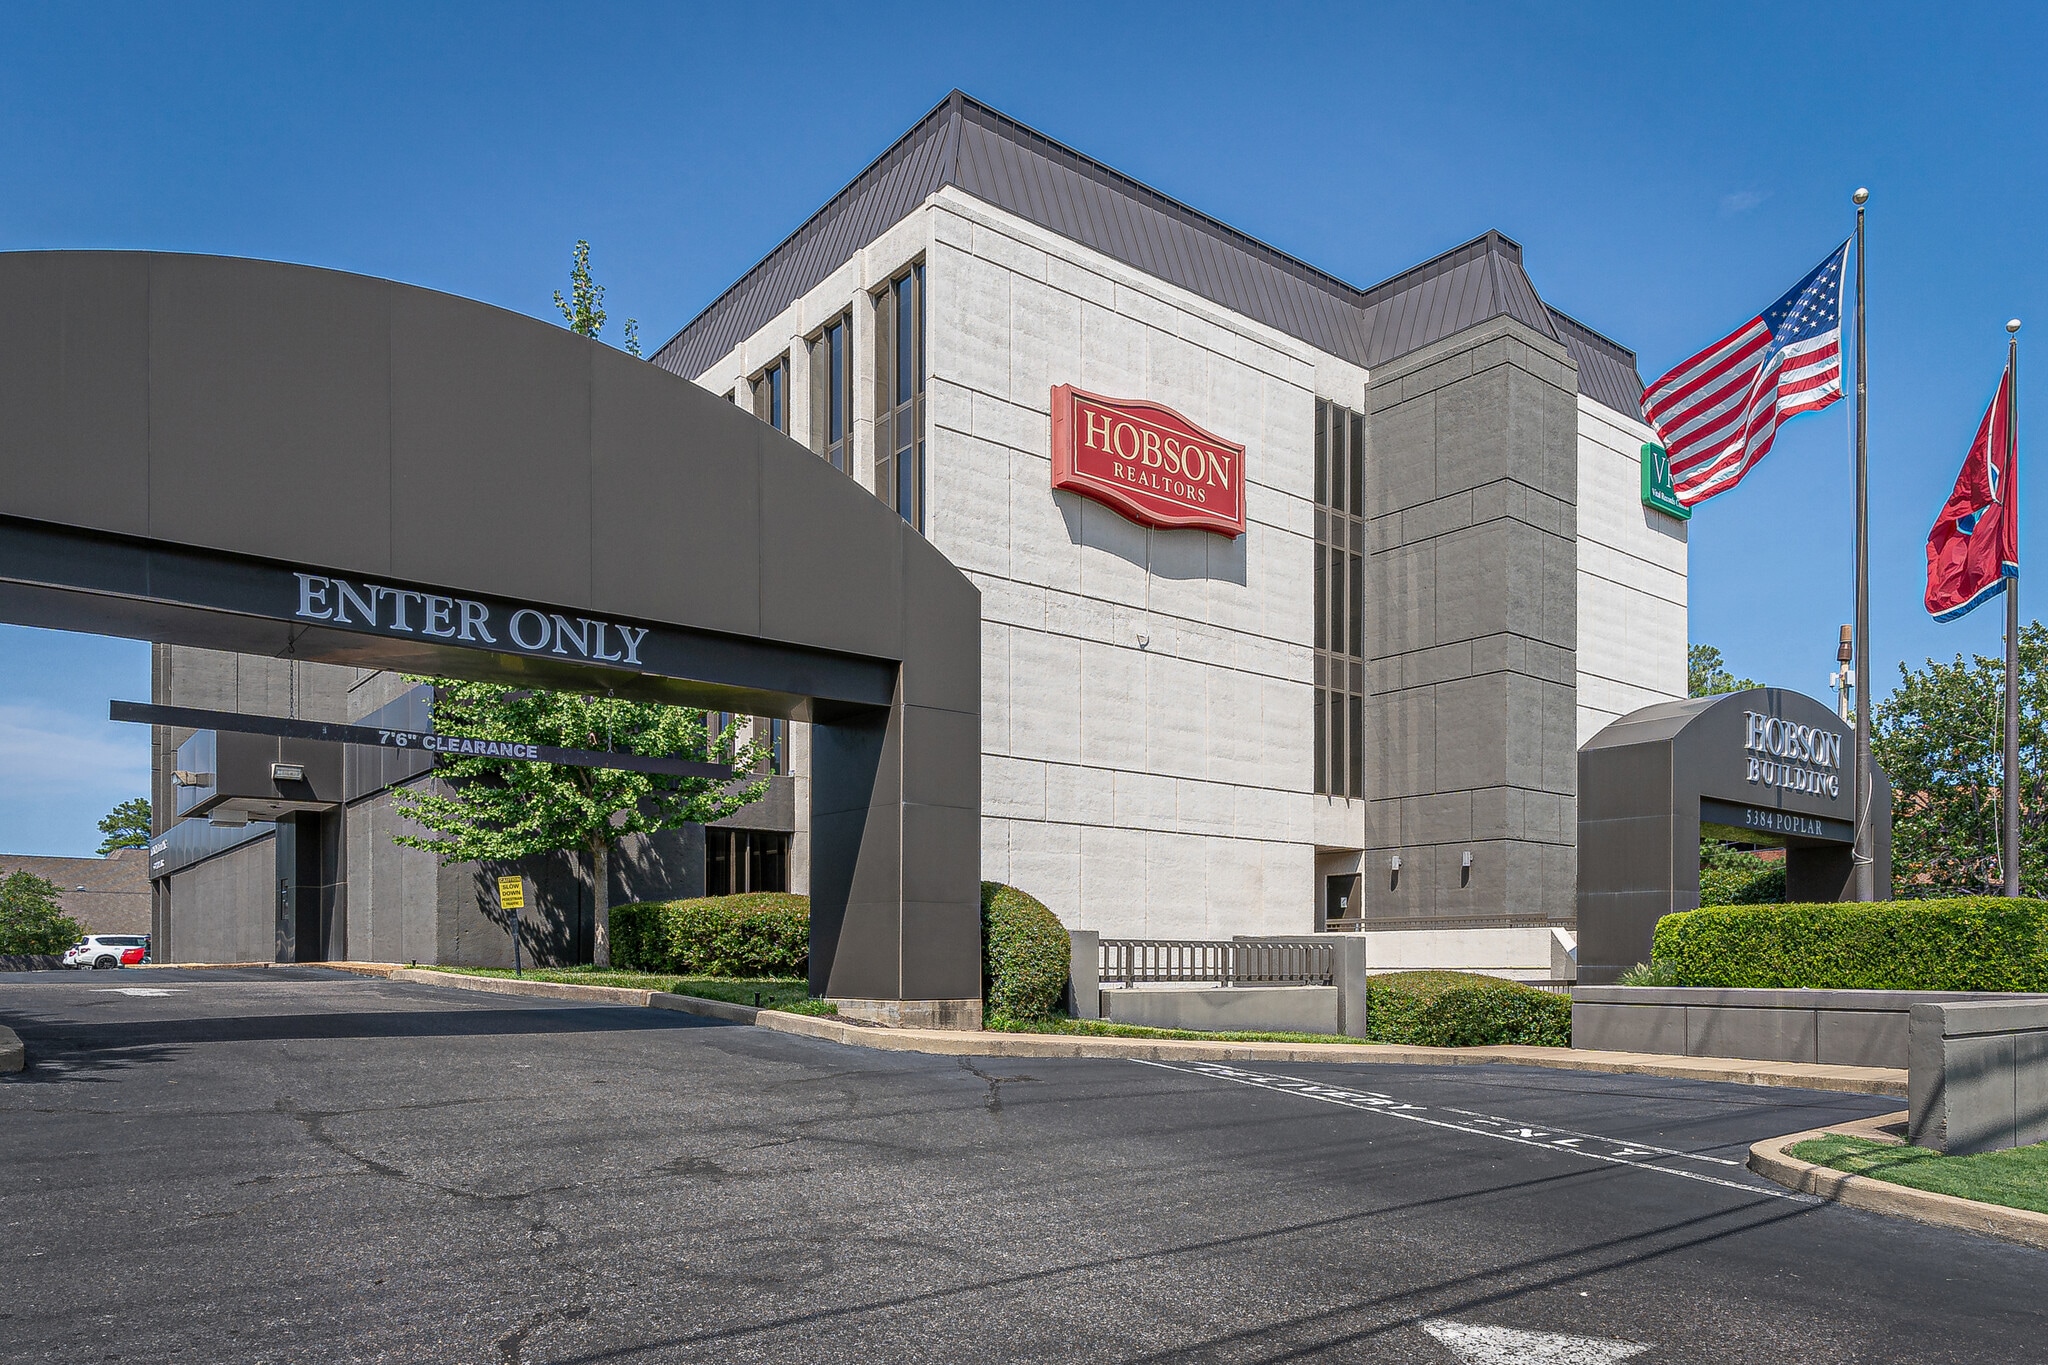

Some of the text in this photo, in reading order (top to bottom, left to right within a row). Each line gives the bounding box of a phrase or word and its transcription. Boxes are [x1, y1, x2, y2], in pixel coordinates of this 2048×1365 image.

[1083, 409, 1231, 491] HOBSON
[1113, 461, 1207, 503] REALTORS
[293, 572, 650, 665] ENTER ONLY
[378, 730, 538, 759] 7'6" CLEARANCE
[1743, 711, 1842, 769] HOBSON
[1746, 757, 1840, 797] BUILDING
[1746, 809, 1823, 836] 5384 POPLAR
